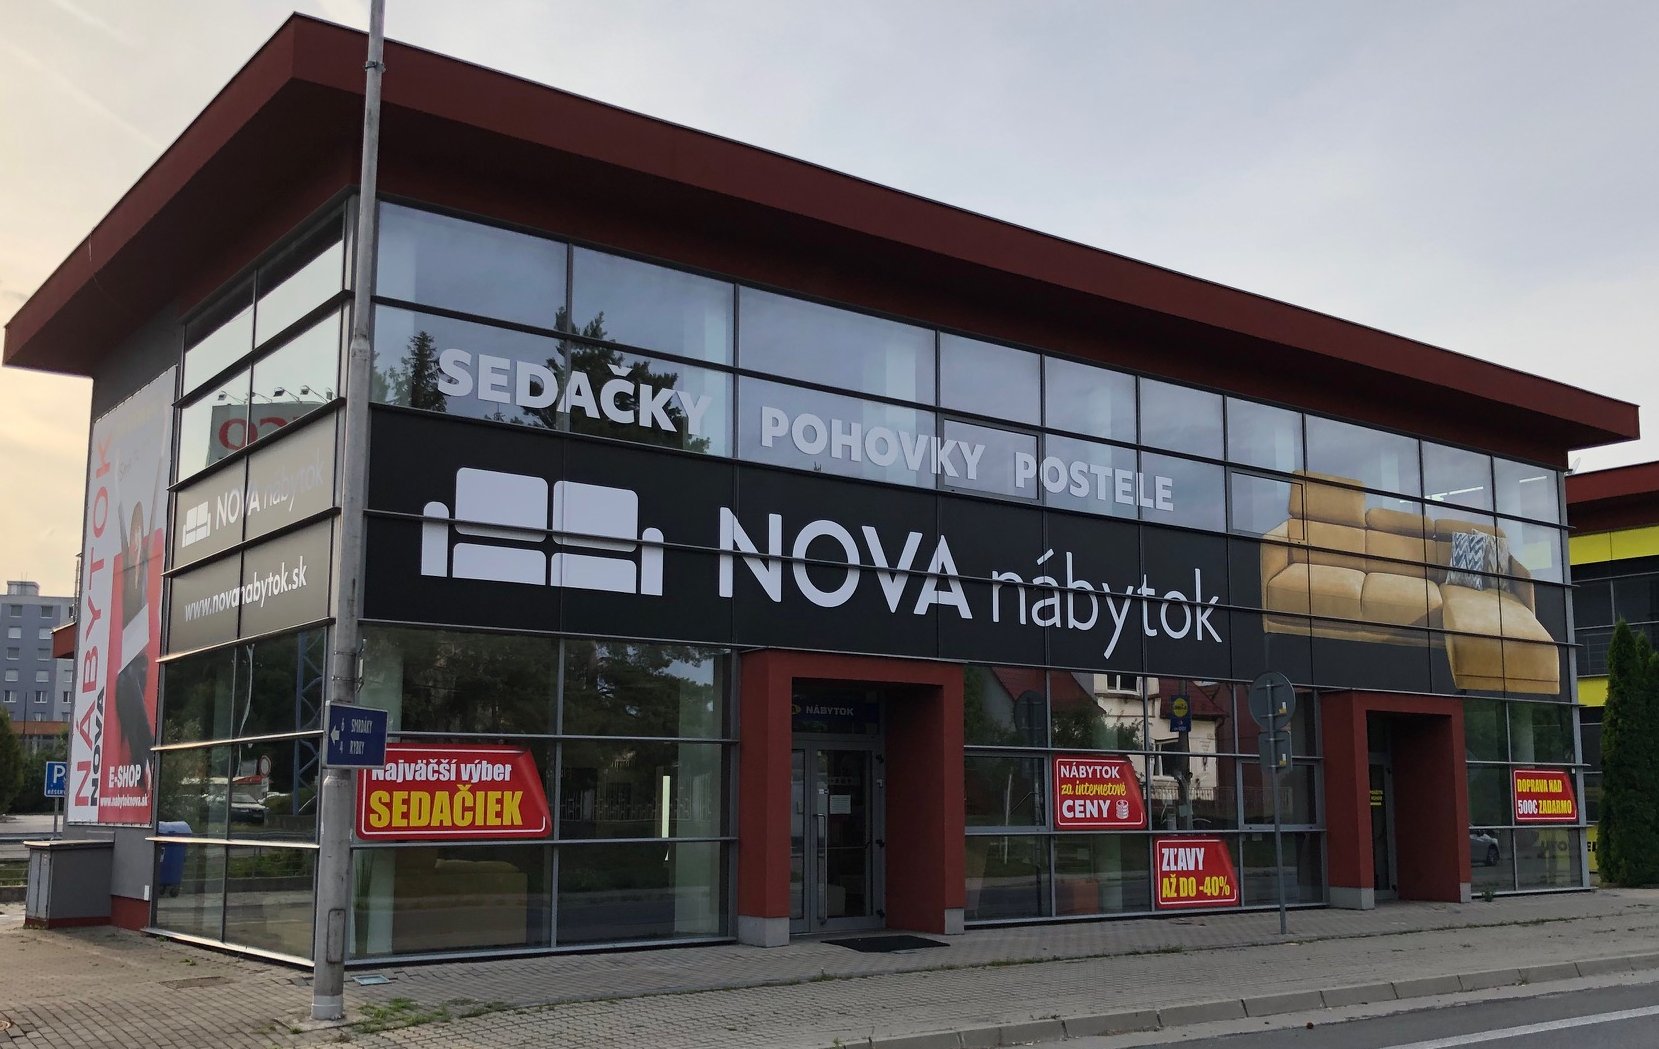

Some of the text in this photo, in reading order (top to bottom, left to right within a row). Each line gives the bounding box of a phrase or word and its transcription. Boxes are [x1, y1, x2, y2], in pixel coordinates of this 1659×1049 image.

[437, 348, 1174, 512] SEDAČKY POHOVKY POSTELE
[215, 479, 260, 530] NOVA
[185, 556, 307, 622] www.novanabytok.sk
[719, 507, 1222, 660] NOVA nábytok
[74, 432, 113, 807] NÁBYTOK
[806, 704, 854, 716] NÁBYTOK
[90, 686, 105, 807] NOVA
[53, 765, 65, 784] P
[109, 764, 142, 788] E-SHOP
[372, 759, 512, 783] Najväčší výber
[1060, 762, 1120, 778] NÁBYTOK
[1061, 780, 1127, 796] za internetové
[1517, 779, 1563, 793] DOPRAVA NAD
[369, 784, 523, 828] SEDAČIEK
[1062, 799, 1111, 818] CENY
[1518, 800, 1572, 815] 500€ ZADARMO
[1162, 847, 1205, 871] ZĽAVY
[1162, 873, 1231, 898] AŽ DO -40%
